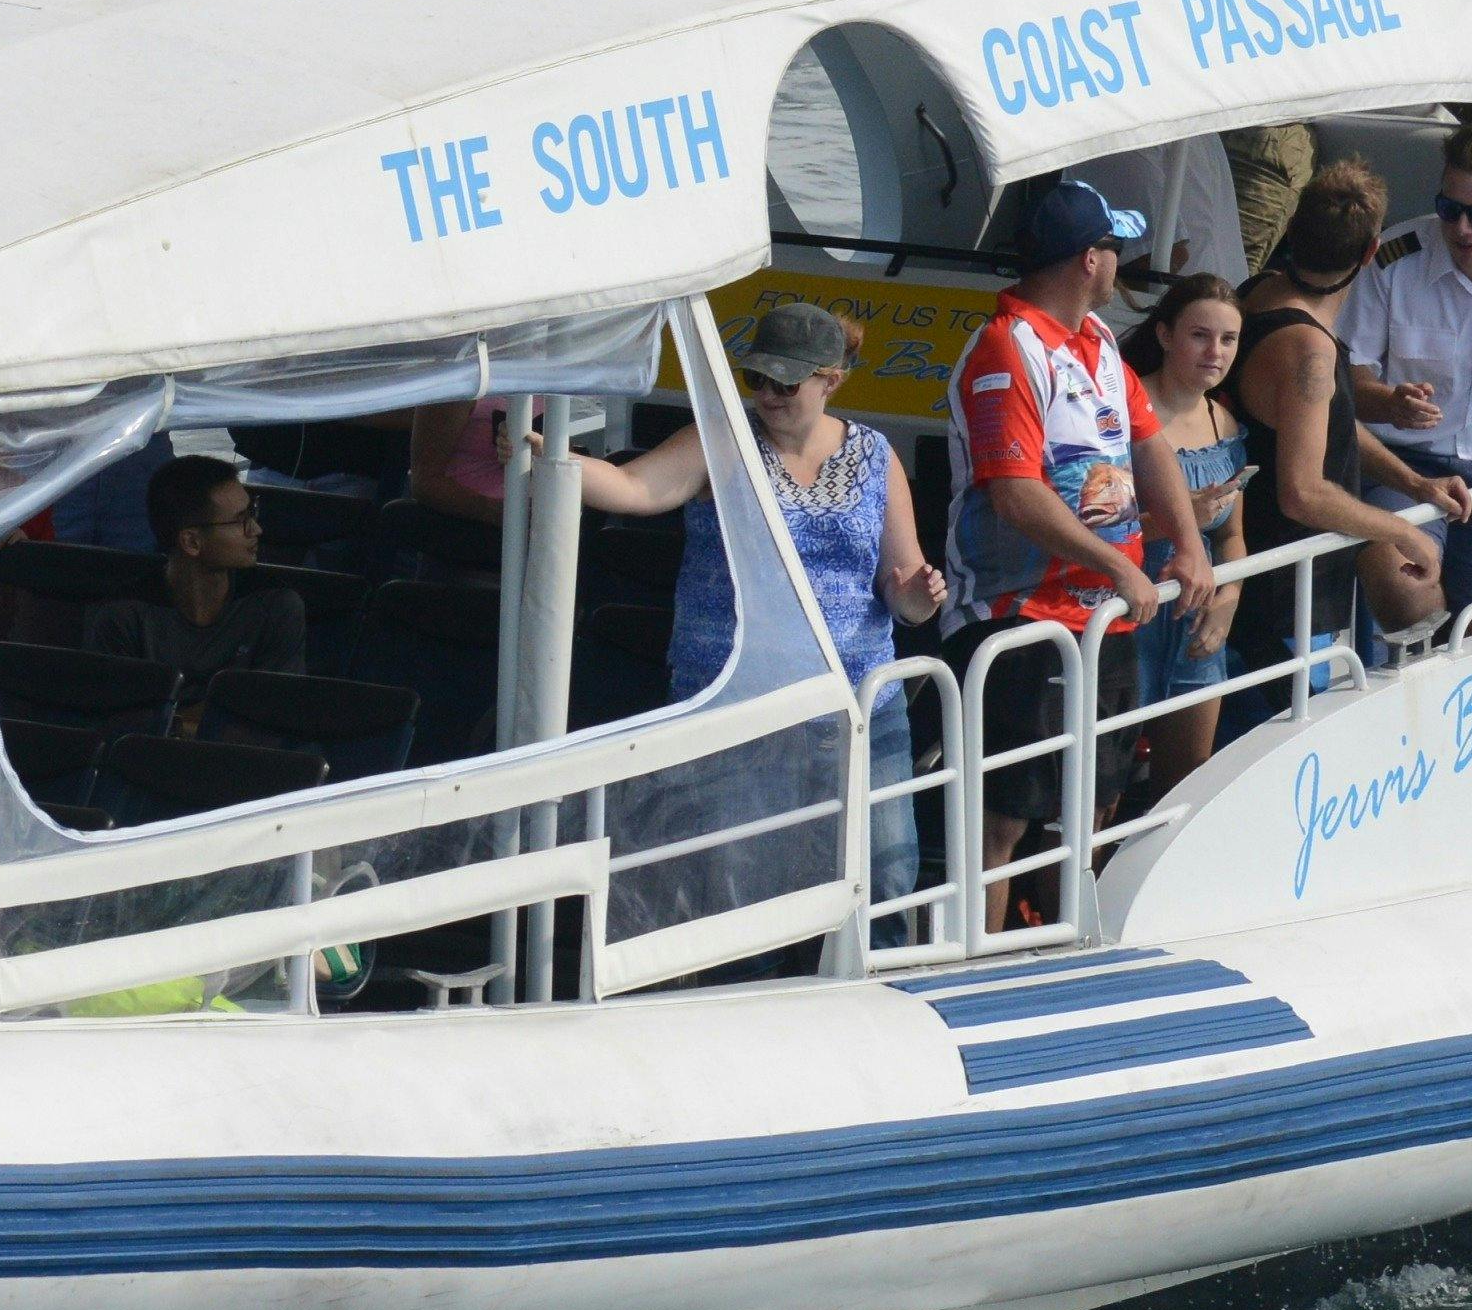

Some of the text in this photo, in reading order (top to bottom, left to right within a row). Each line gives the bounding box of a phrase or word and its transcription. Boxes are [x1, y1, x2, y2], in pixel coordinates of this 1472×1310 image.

[381, 137, 502, 242] THE
[533, 91, 729, 213] SOUTH
[983, 2, 1149, 115] COAST
[892, 305, 937, 327] US
[950, 309, 989, 333] TO
[1294, 736, 1435, 899] Jervis
